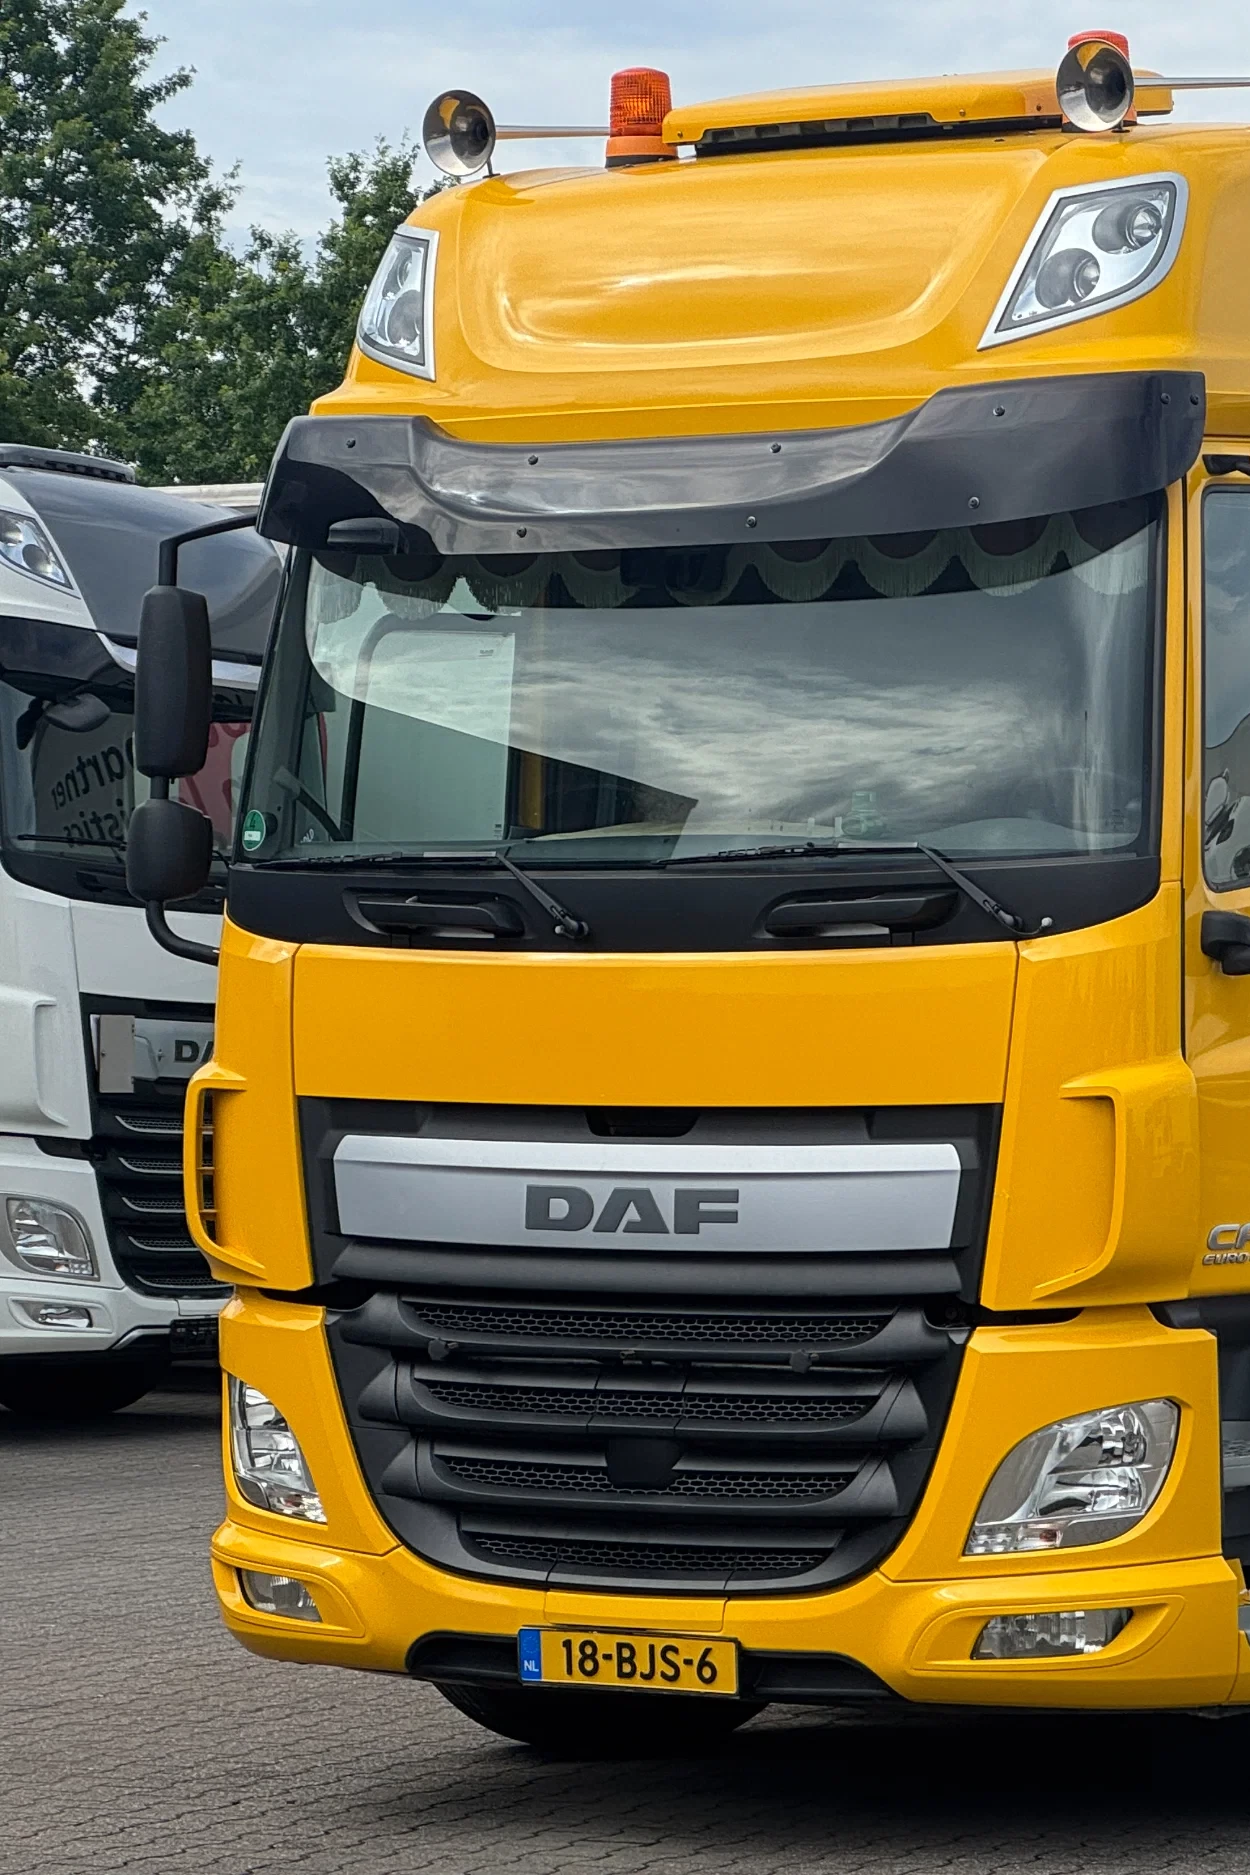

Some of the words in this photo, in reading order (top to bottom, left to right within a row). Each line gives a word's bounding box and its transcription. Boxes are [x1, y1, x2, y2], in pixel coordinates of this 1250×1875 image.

[525, 1184, 739, 1235] DAF
[1202, 1252, 1250, 1266] EURO
[524, 1659, 539, 1672] NL
[561, 1638, 718, 1684] 18-BJS-6
